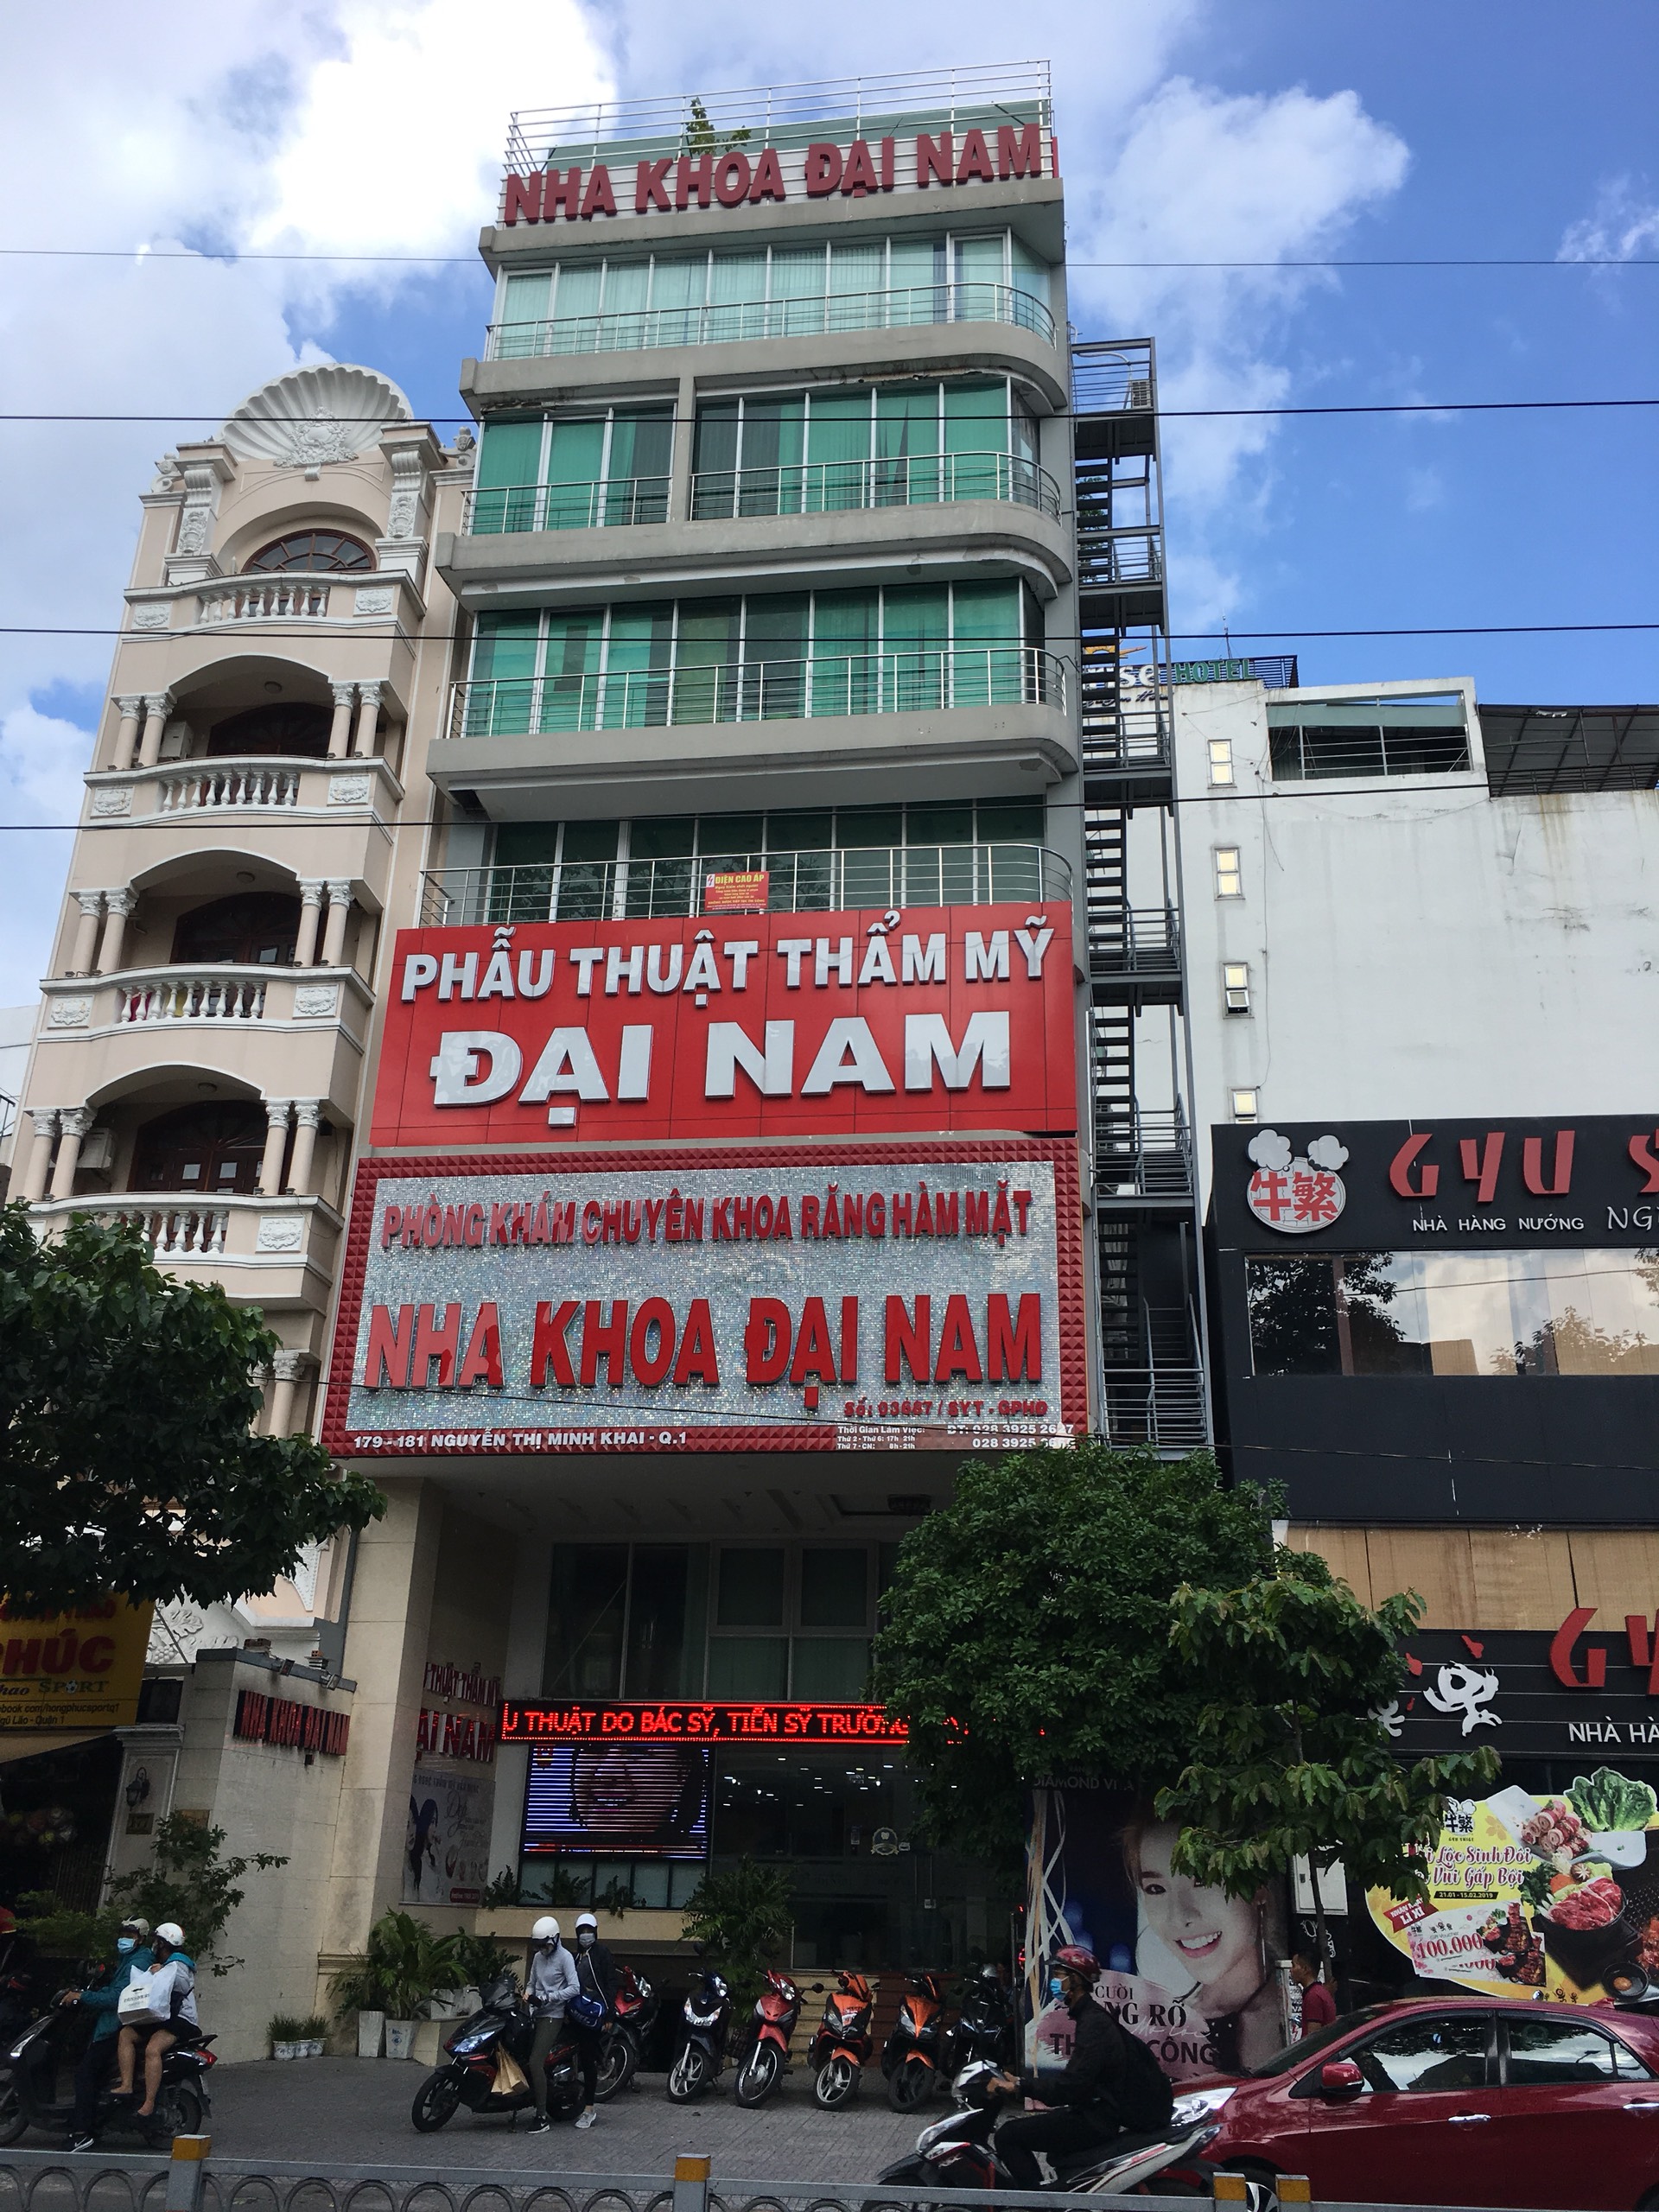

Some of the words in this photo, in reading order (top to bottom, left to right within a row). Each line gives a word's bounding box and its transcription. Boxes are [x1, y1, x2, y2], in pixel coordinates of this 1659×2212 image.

[504, 165, 617, 226] NHA
[635, 148, 785, 213] KHOA
[805, 137, 895, 199] ĐẠI
[917, 124, 1041, 188] NAM
[1174, 658, 1257, 684] HOTEL
[401, 926, 556, 1003] PHẪU
[569, 929, 759, 1007] THUẬT
[778, 910, 947, 990] THẨM
[964, 915, 1055, 982] MỸ
[430, 1024, 654, 1128] ĐẠI
[705, 1011, 1011, 1099] NAM
[1389, 1129, 1576, 1203] GYU
[381, 1193, 486, 1248] PHÒNG
[490, 1191, 576, 1246] KHÁM
[582, 1188, 705, 1245] CHUYÊN
[712, 1194, 793, 1240] KHOA
[801, 1181, 887, 1239] RĂNG
[893, 1181, 959, 1237] HÀM
[966, 1179, 1032, 1247] MẶT
[1413, 1215, 1448, 1232] NHÀ
[1459, 1215, 1507, 1231] HÀNG
[1519, 1215, 1585, 1231] NƯỚNG
[1606, 1205, 1659, 1231] NG
[365, 1302, 507, 1389] NHA
[531, 1296, 720, 1388] KHOA
[743, 1296, 860, 1410] ĐẠI
[883, 1293, 1042, 1385] NAM
[844, 1396, 873, 1417] Số:
[878, 1400, 933, 1417] 03687
[937, 1400, 944, 1415] /
[947, 1399, 984, 1417] SYT
[353, 1435, 383, 1448] 179
[397, 1434, 425, 1447] 181
[431, 1427, 506, 1447] NGUYỄN
[512, 1433, 542, 1449] THỊ
[548, 1433, 595, 1446] MINH
[601, 1432, 645, 1445] KHAI
[658, 1432, 687, 1446] Q.1
[972, 1424, 999, 1434] 028
[1002, 1424, 1036, 1434] 3925
[972, 1438, 999, 1448] 028
[1002, 1438, 1037, 1448] 3925
[0, 1628, 116, 1675] HÚC
[524, 1706, 596, 1736] THUẬT
[602, 1711, 635, 1732] DO
[641, 1707, 683, 1732] BÁC
[728, 1707, 778, 1733] TIẾN
[785, 1706, 812, 1732] SỸ
[1568, 1716, 1621, 1743] NHÀ
[1436, 1846, 1464, 1870] Lộc
[1465, 1845, 1502, 1864] Sinh
[1504, 1846, 1533, 1864] Đôi
[1433, 1867, 1460, 1885] Vui
[1464, 1865, 1494, 1891] Gấp
[1497, 1866, 1525, 1888] Bội
[1416, 1933, 1484, 1960] 100.000
[1095, 1983, 1134, 2000] CƯỜI
[1149, 2036, 1216, 2066] CÔNG
